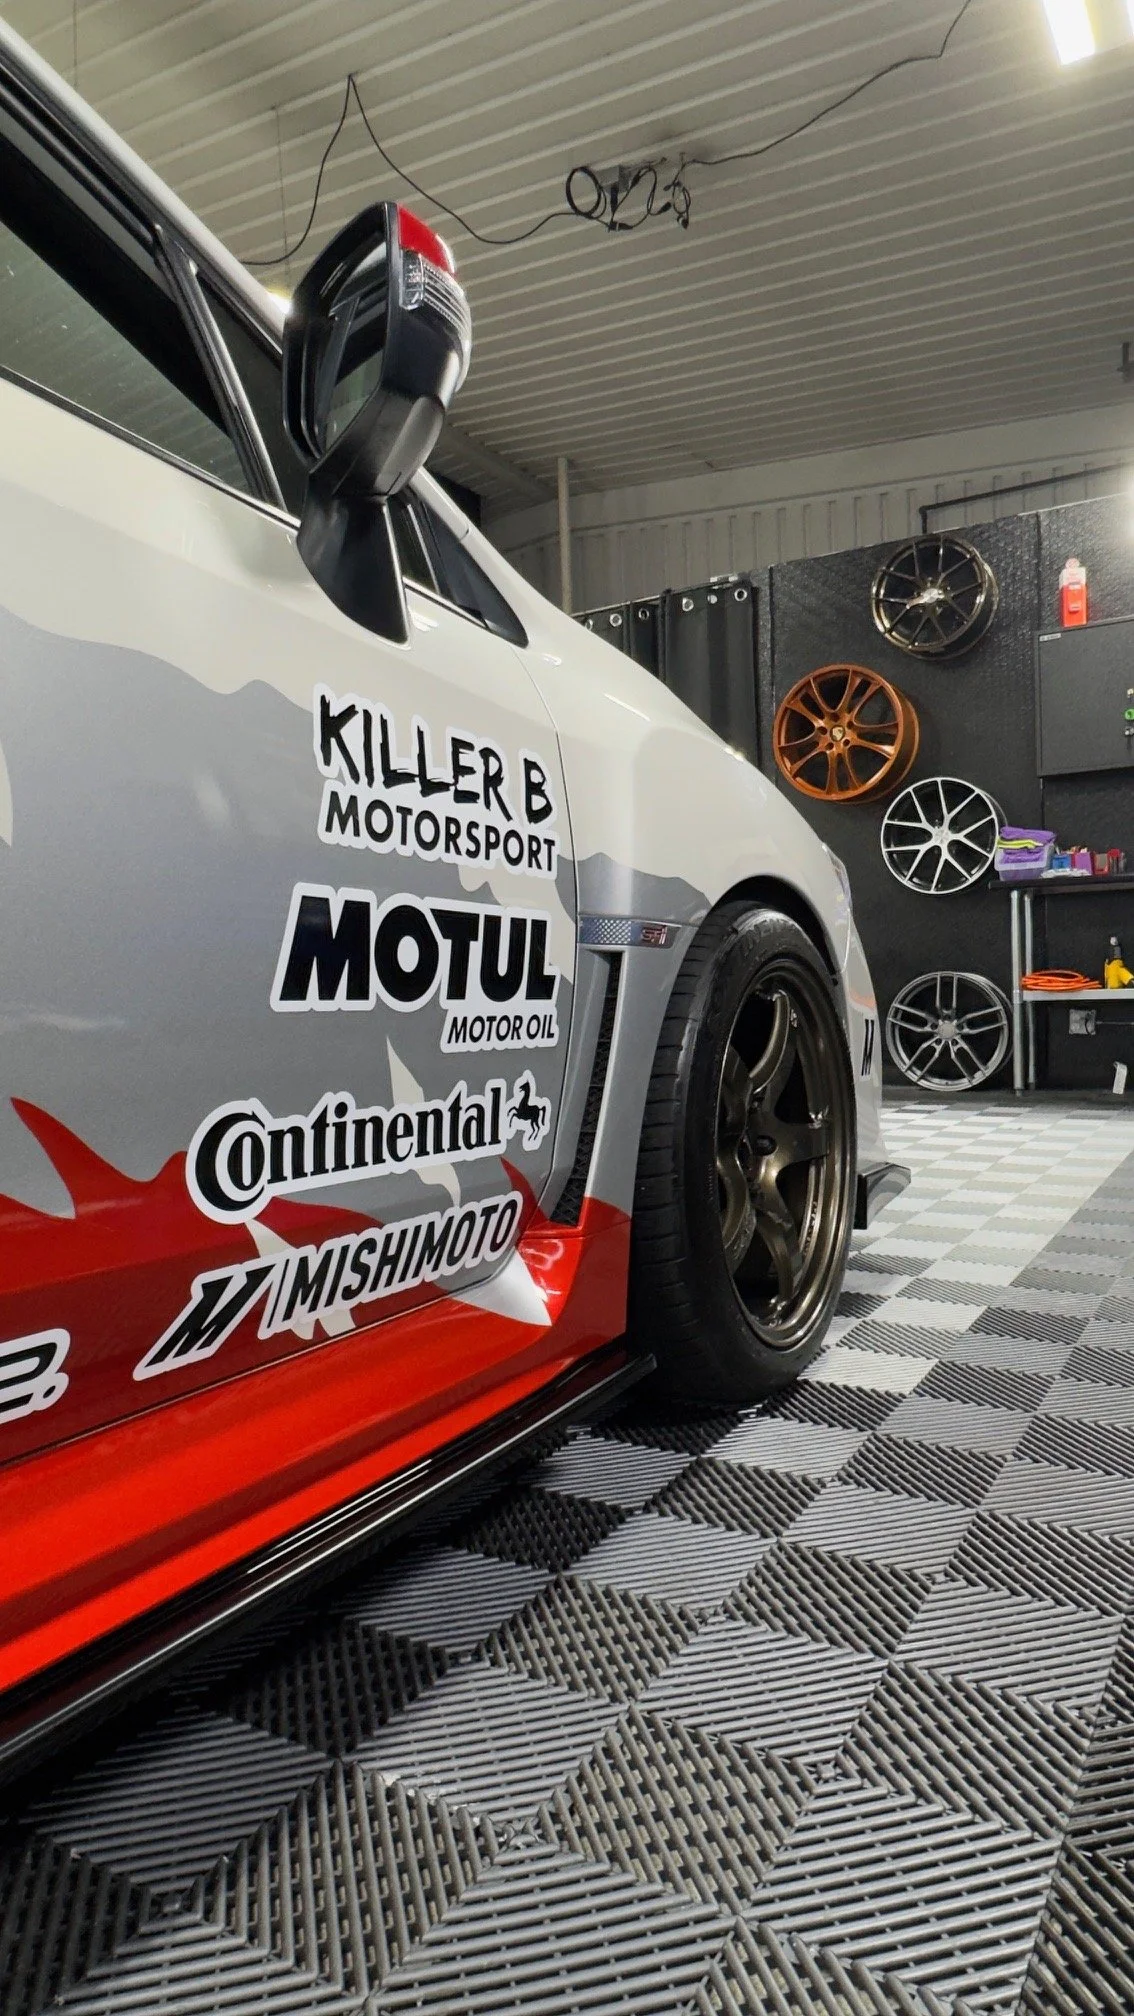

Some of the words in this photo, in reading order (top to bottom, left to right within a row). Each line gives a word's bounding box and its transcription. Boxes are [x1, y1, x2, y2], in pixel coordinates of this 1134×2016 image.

[319, 694, 513, 820] KILLER
[523, 757, 554, 825] B
[325, 790, 556, 872] MOTORSPORT
[279, 894, 557, 1003] MOTUL
[446, 1015, 522, 1045] MOTOR
[525, 1014, 555, 1040] OIL
[194, 1086, 502, 1213] Continental
[281, 1198, 519, 1324] MISHIMOTO
